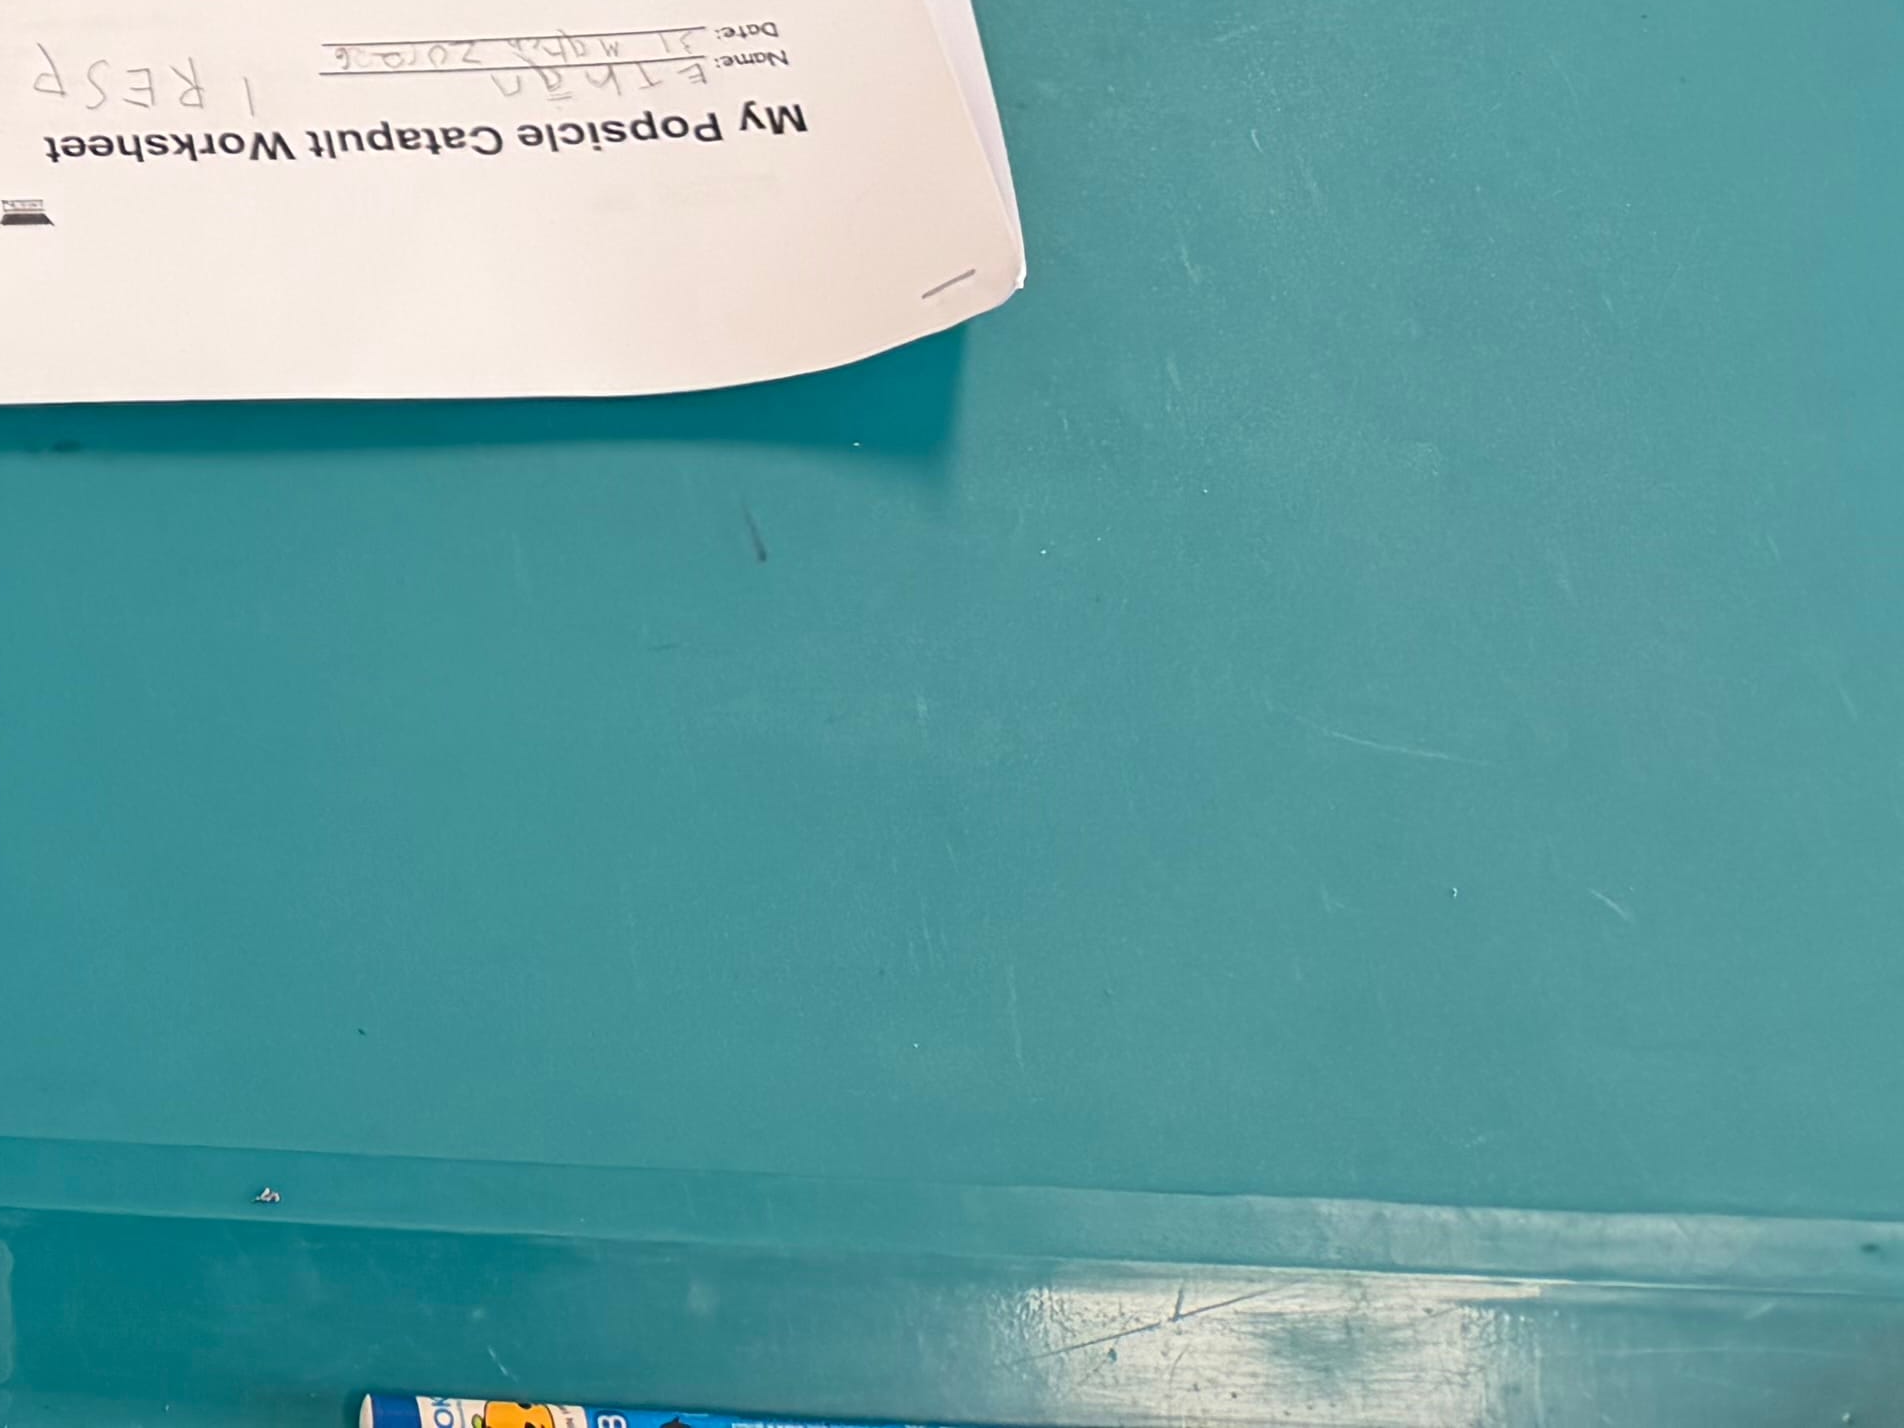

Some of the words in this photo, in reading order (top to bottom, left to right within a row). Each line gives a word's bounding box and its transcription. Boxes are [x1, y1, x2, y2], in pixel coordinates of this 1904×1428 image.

[714, 21, 780, 40] Date:
[714, 49, 790, 69] Name:
[517, 110, 724, 153] Popsicle
[739, 100, 809, 135] My
[43, 131, 297, 163] Worksheet
[305, 121, 504, 159] Catapult
